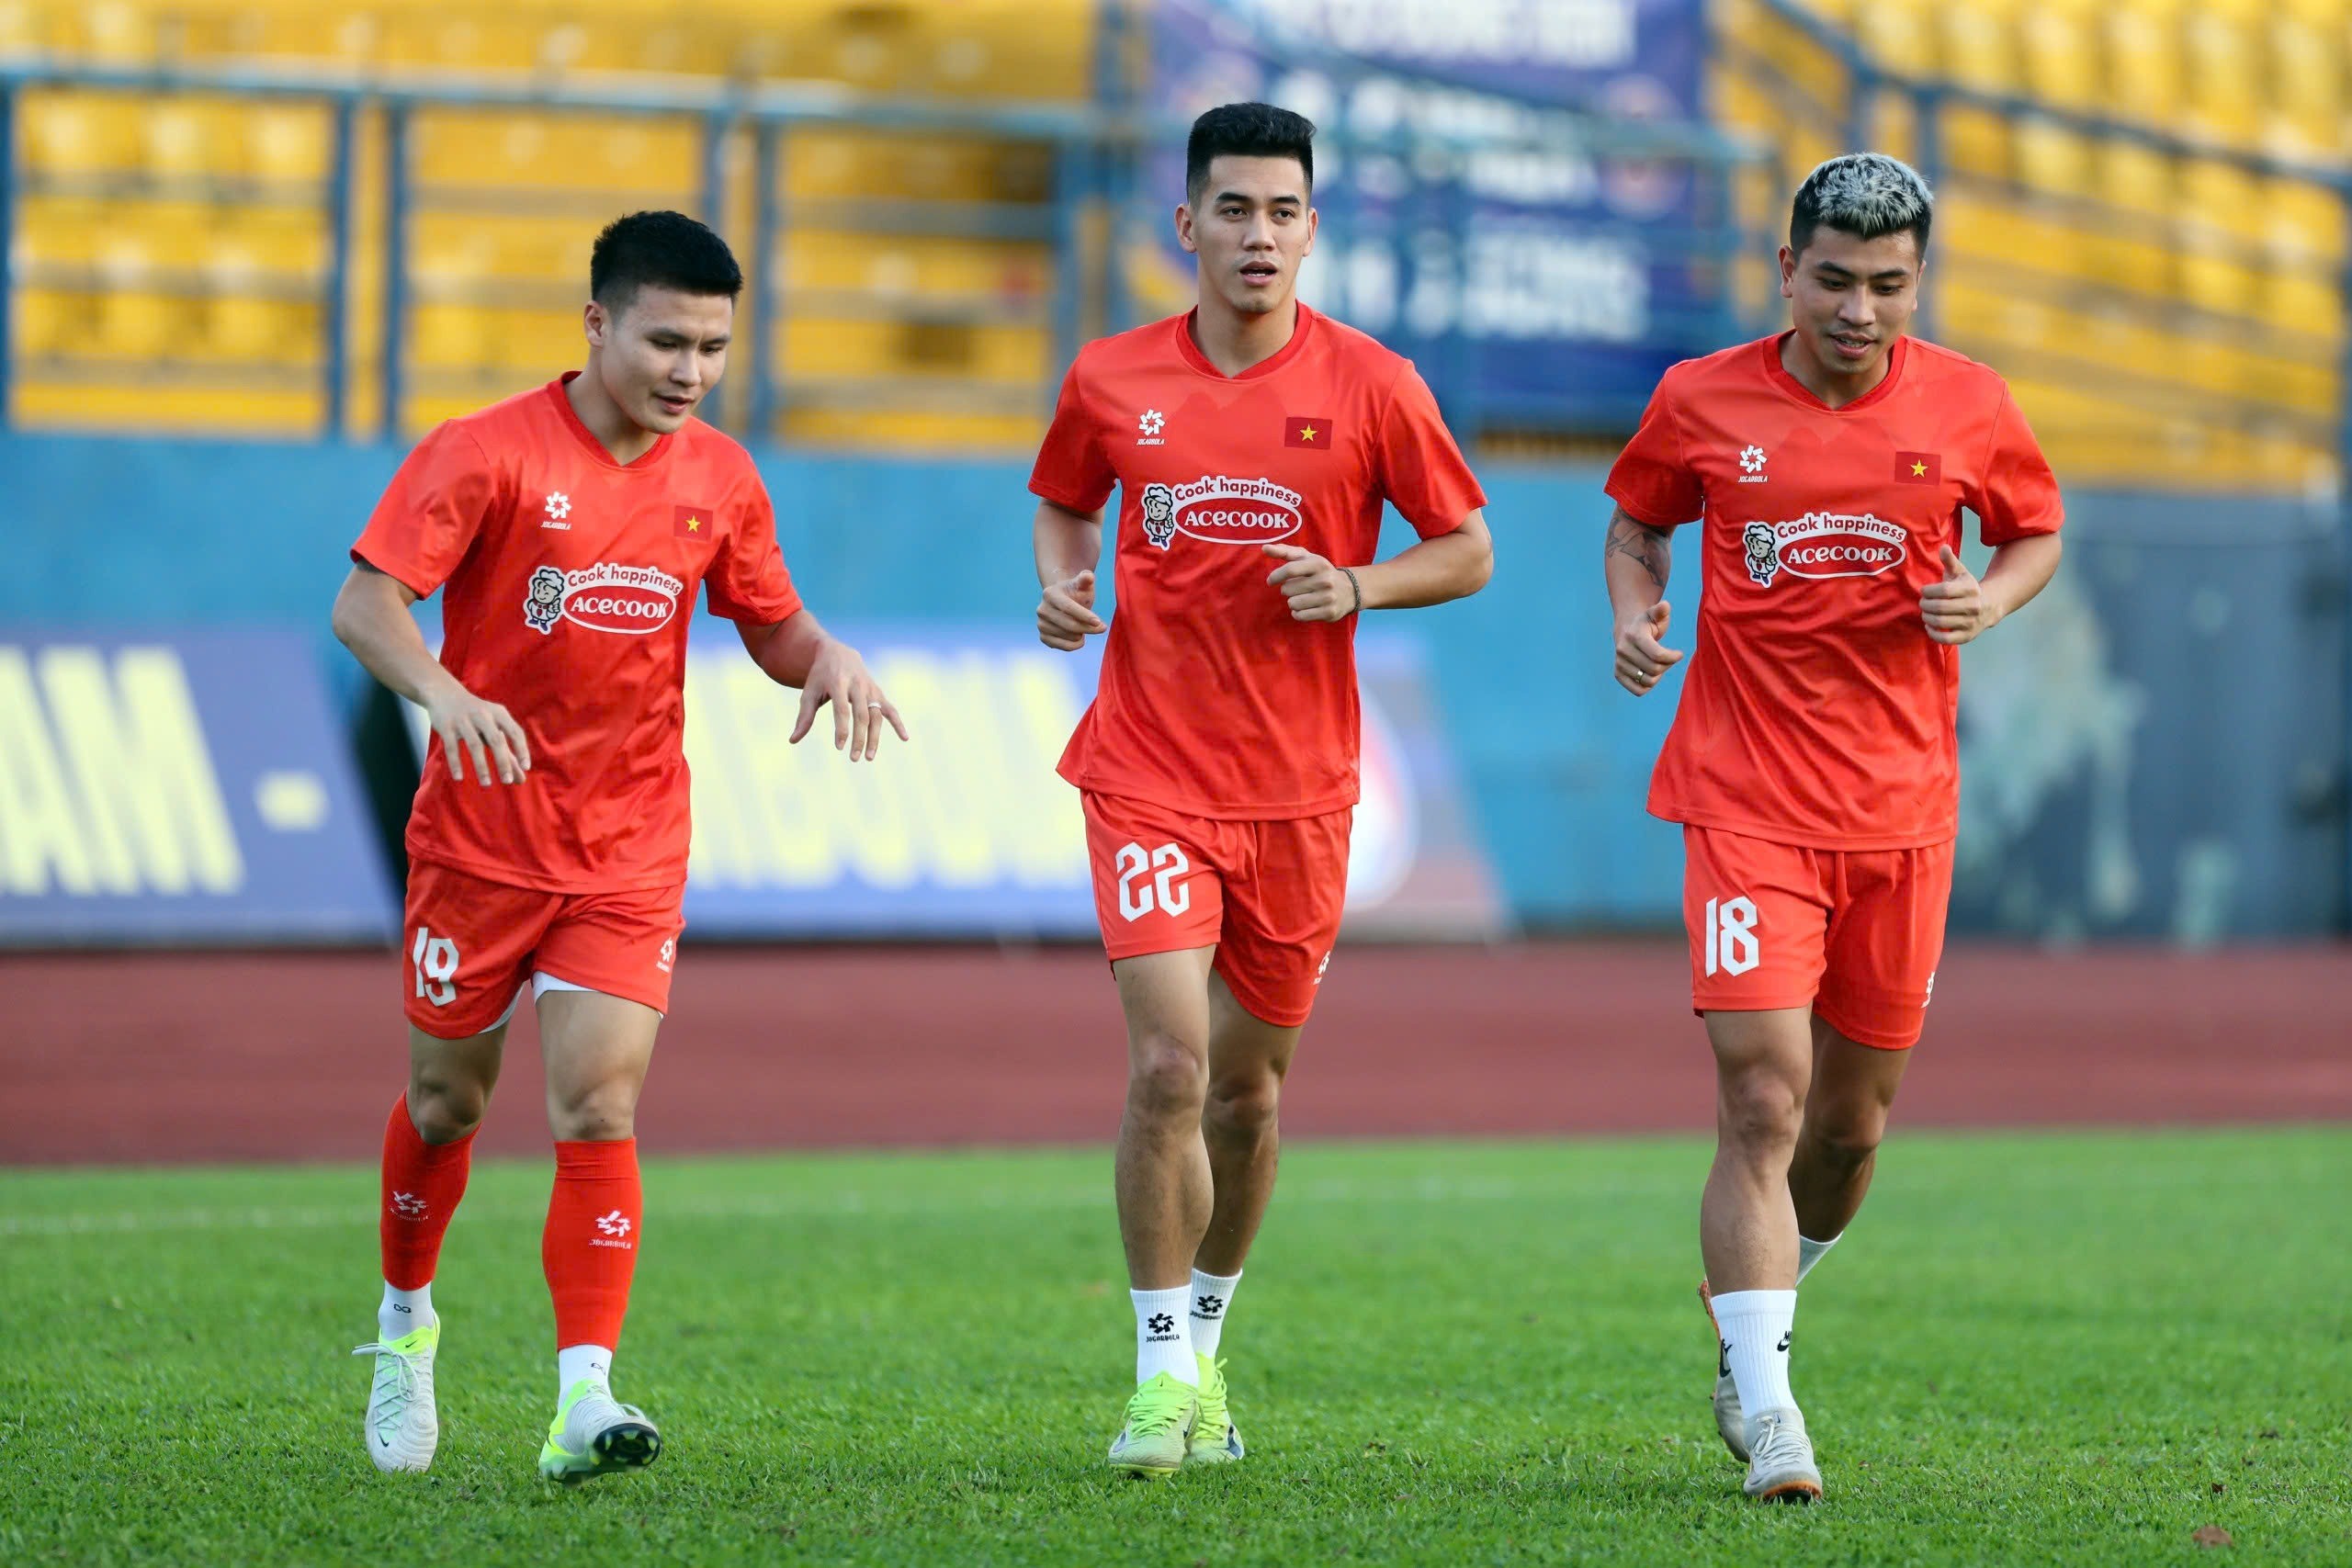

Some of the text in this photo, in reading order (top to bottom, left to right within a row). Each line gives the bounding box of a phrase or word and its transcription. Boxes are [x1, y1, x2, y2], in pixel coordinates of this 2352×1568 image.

[1174, 478, 1300, 507] Cook happiness
[1777, 514, 1905, 541] Cook happiness
[568, 566, 682, 595] Cook happiness
[1115, 841, 1190, 922] 22
[1705, 896, 1760, 978] 18
[413, 927, 459, 1007] 19
